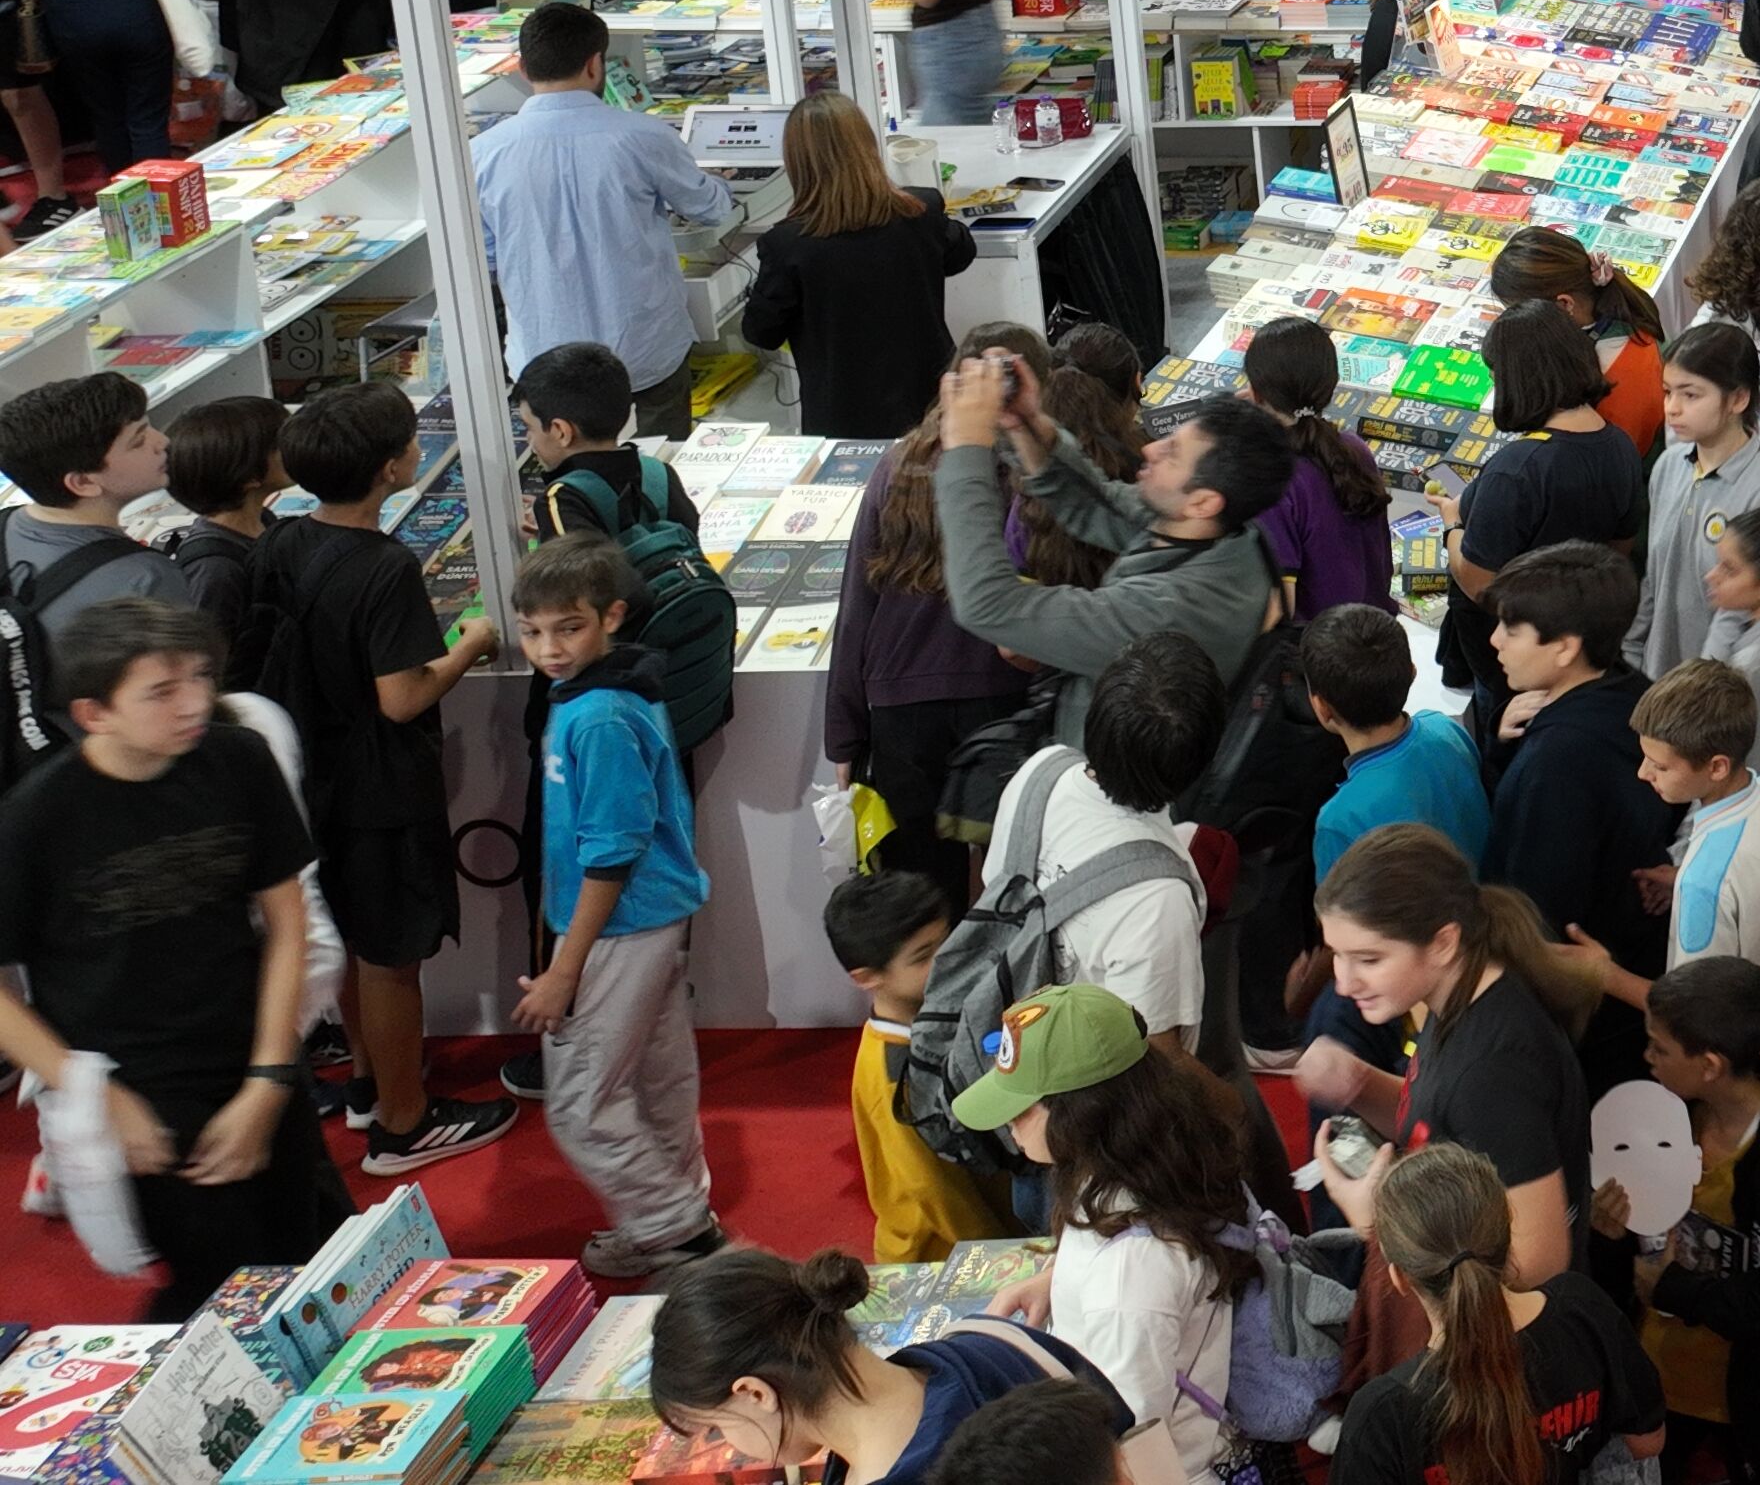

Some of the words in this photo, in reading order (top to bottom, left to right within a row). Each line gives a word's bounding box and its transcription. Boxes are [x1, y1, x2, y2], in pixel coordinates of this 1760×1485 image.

[834, 445, 885, 457] BEYİN
[677, 452, 742, 464] PARADOKS
[791, 488, 848, 498] YARATICI
